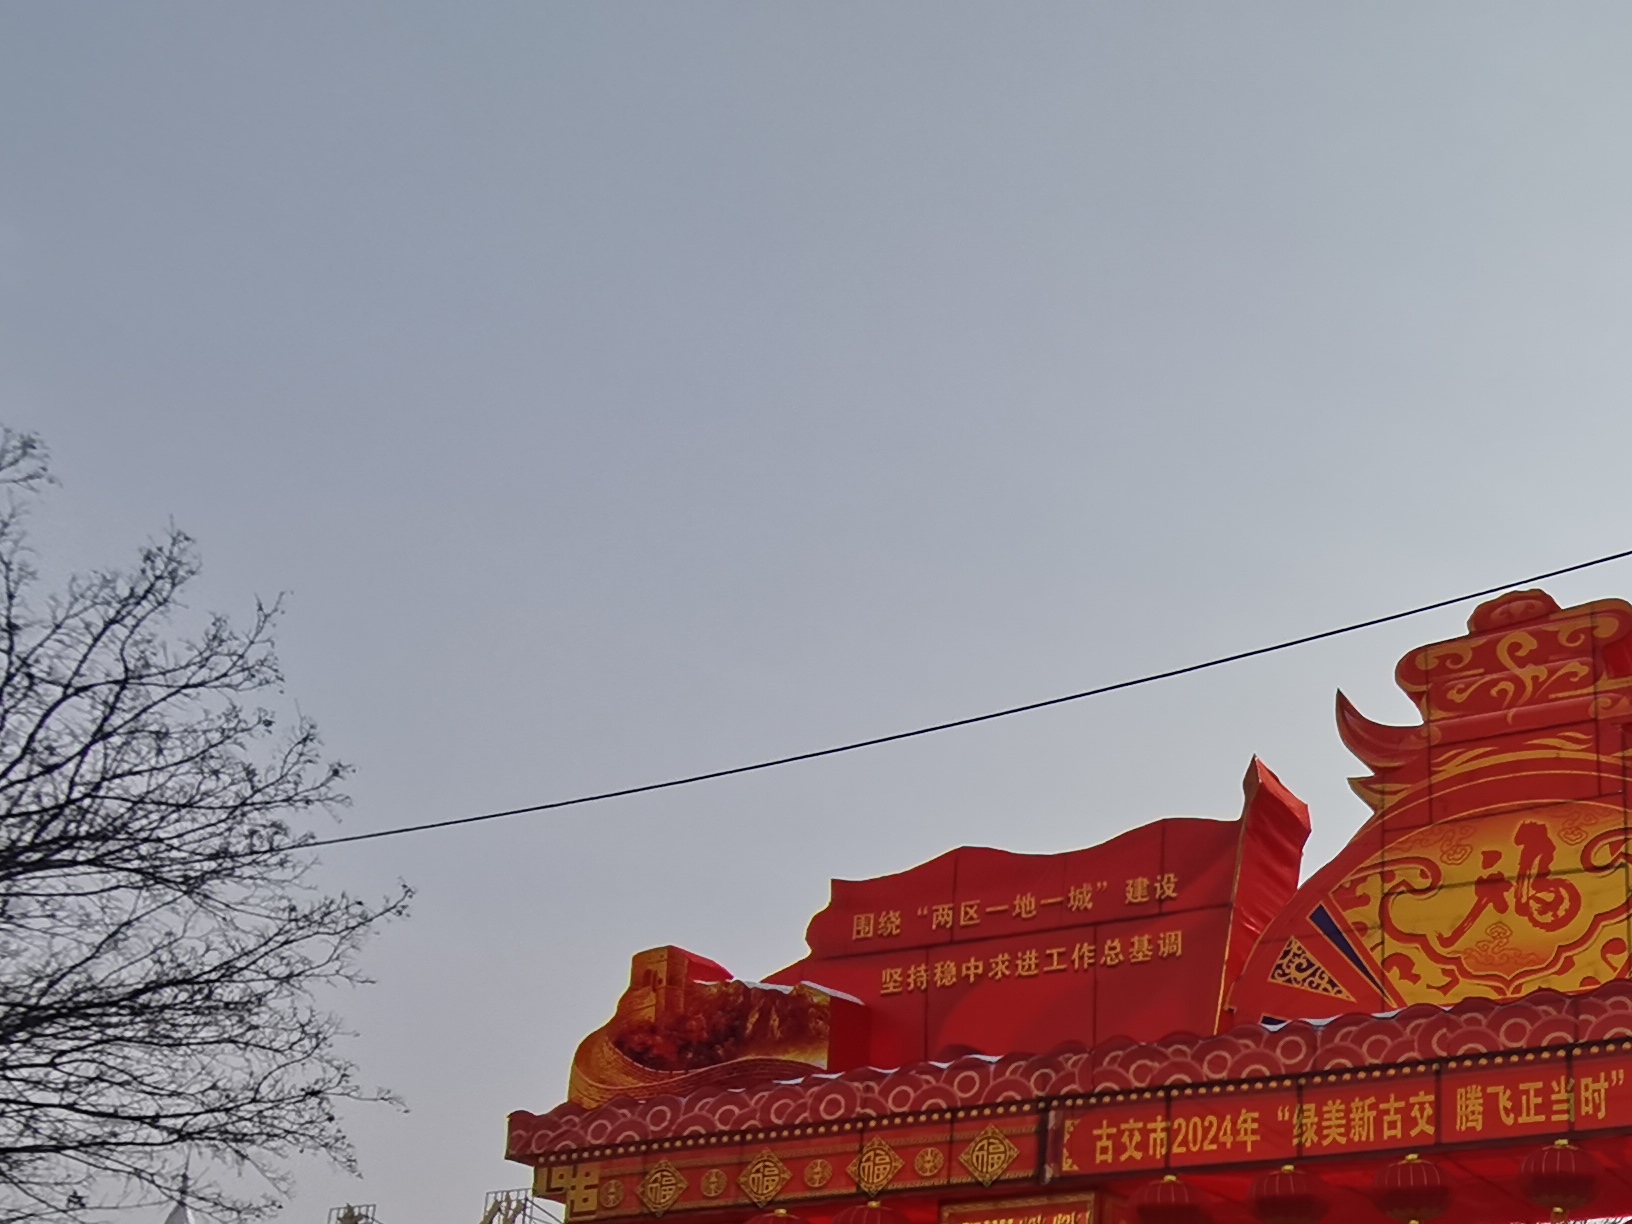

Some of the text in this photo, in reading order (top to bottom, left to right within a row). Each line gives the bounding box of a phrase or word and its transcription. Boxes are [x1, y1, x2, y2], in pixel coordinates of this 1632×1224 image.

[852, 873, 1178, 940] 围绕“两区一地一城”建设
[880, 931, 1182, 994] 坚持稳中求进工作总基调
